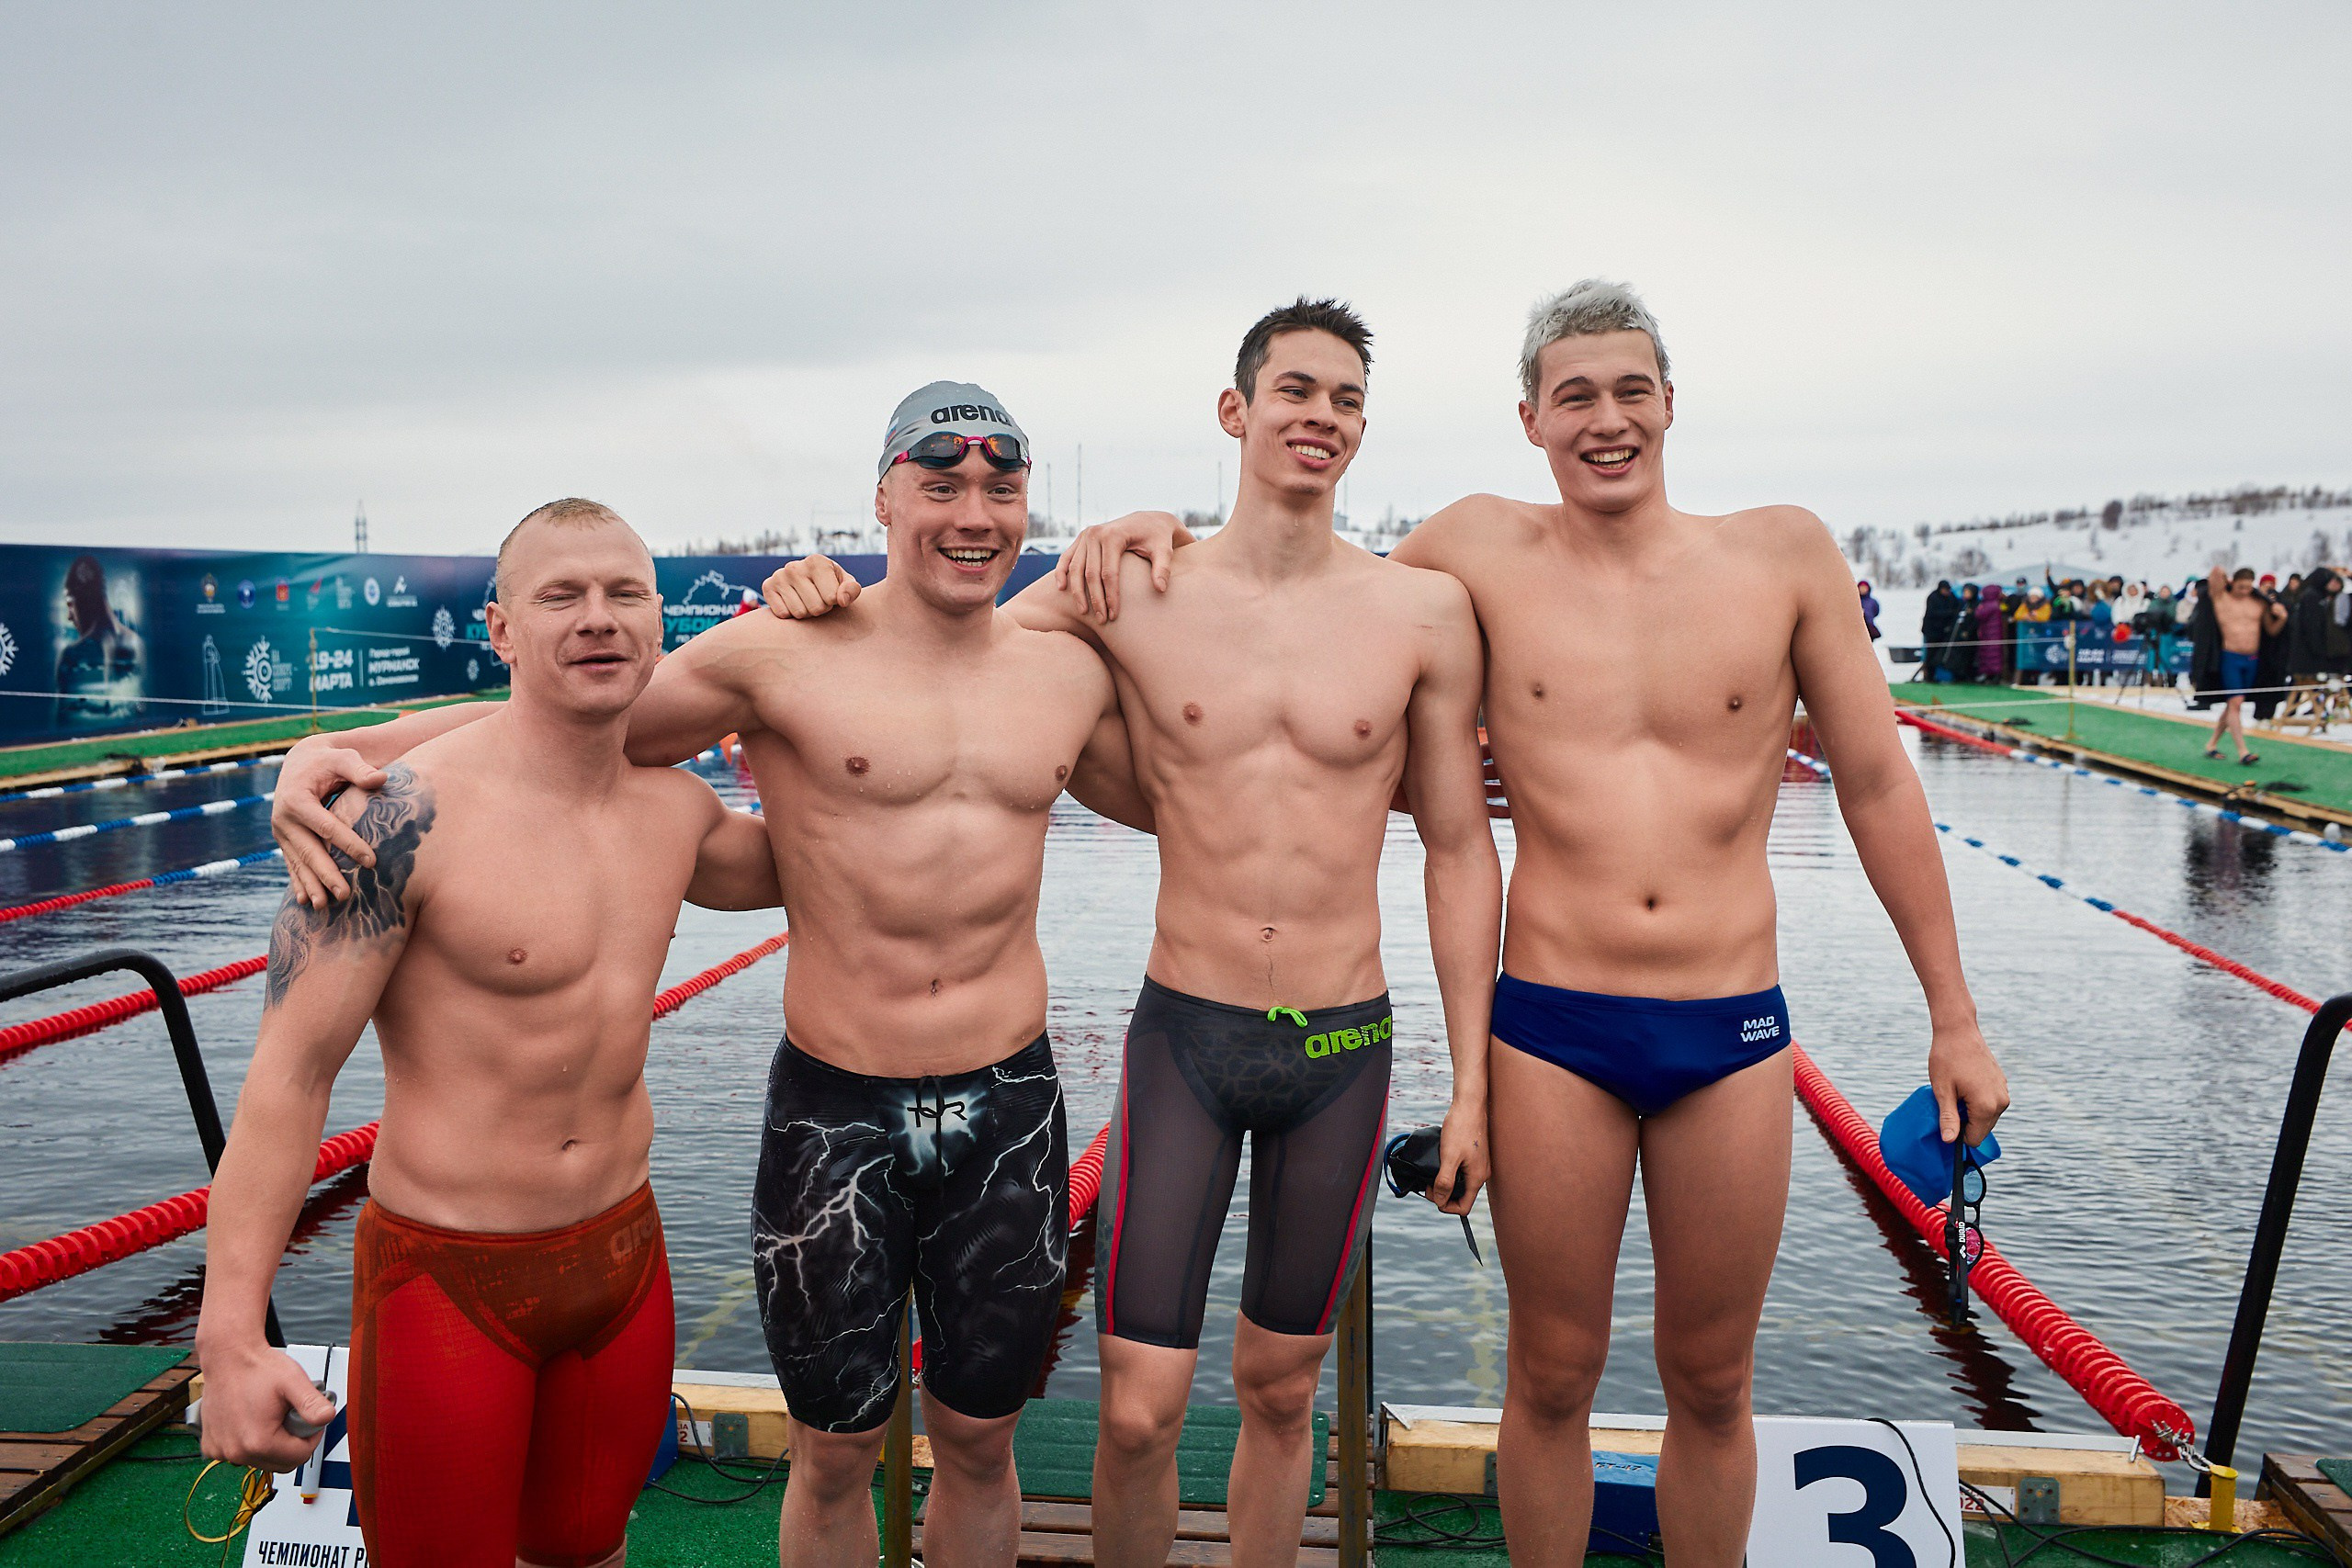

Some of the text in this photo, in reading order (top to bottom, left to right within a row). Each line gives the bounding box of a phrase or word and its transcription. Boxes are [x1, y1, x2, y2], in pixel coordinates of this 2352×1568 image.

[931, 404, 1013, 427] arena
[662, 617, 720, 633] УБОК
[308, 649, 354, 671] 19-24
[368, 658, 421, 674] МУРМАНСК
[309, 671, 354, 693] МАРТА
[1739, 1025, 1781, 1043] WAVE
[1743, 1015, 1775, 1031] MAD
[1305, 1015, 1392, 1059] arena
[1958, 1221, 1966, 1243] arena
[1793, 1445, 1917, 1568] 3
[258, 1540, 350, 1568] ЧЕМПИОНАТ
